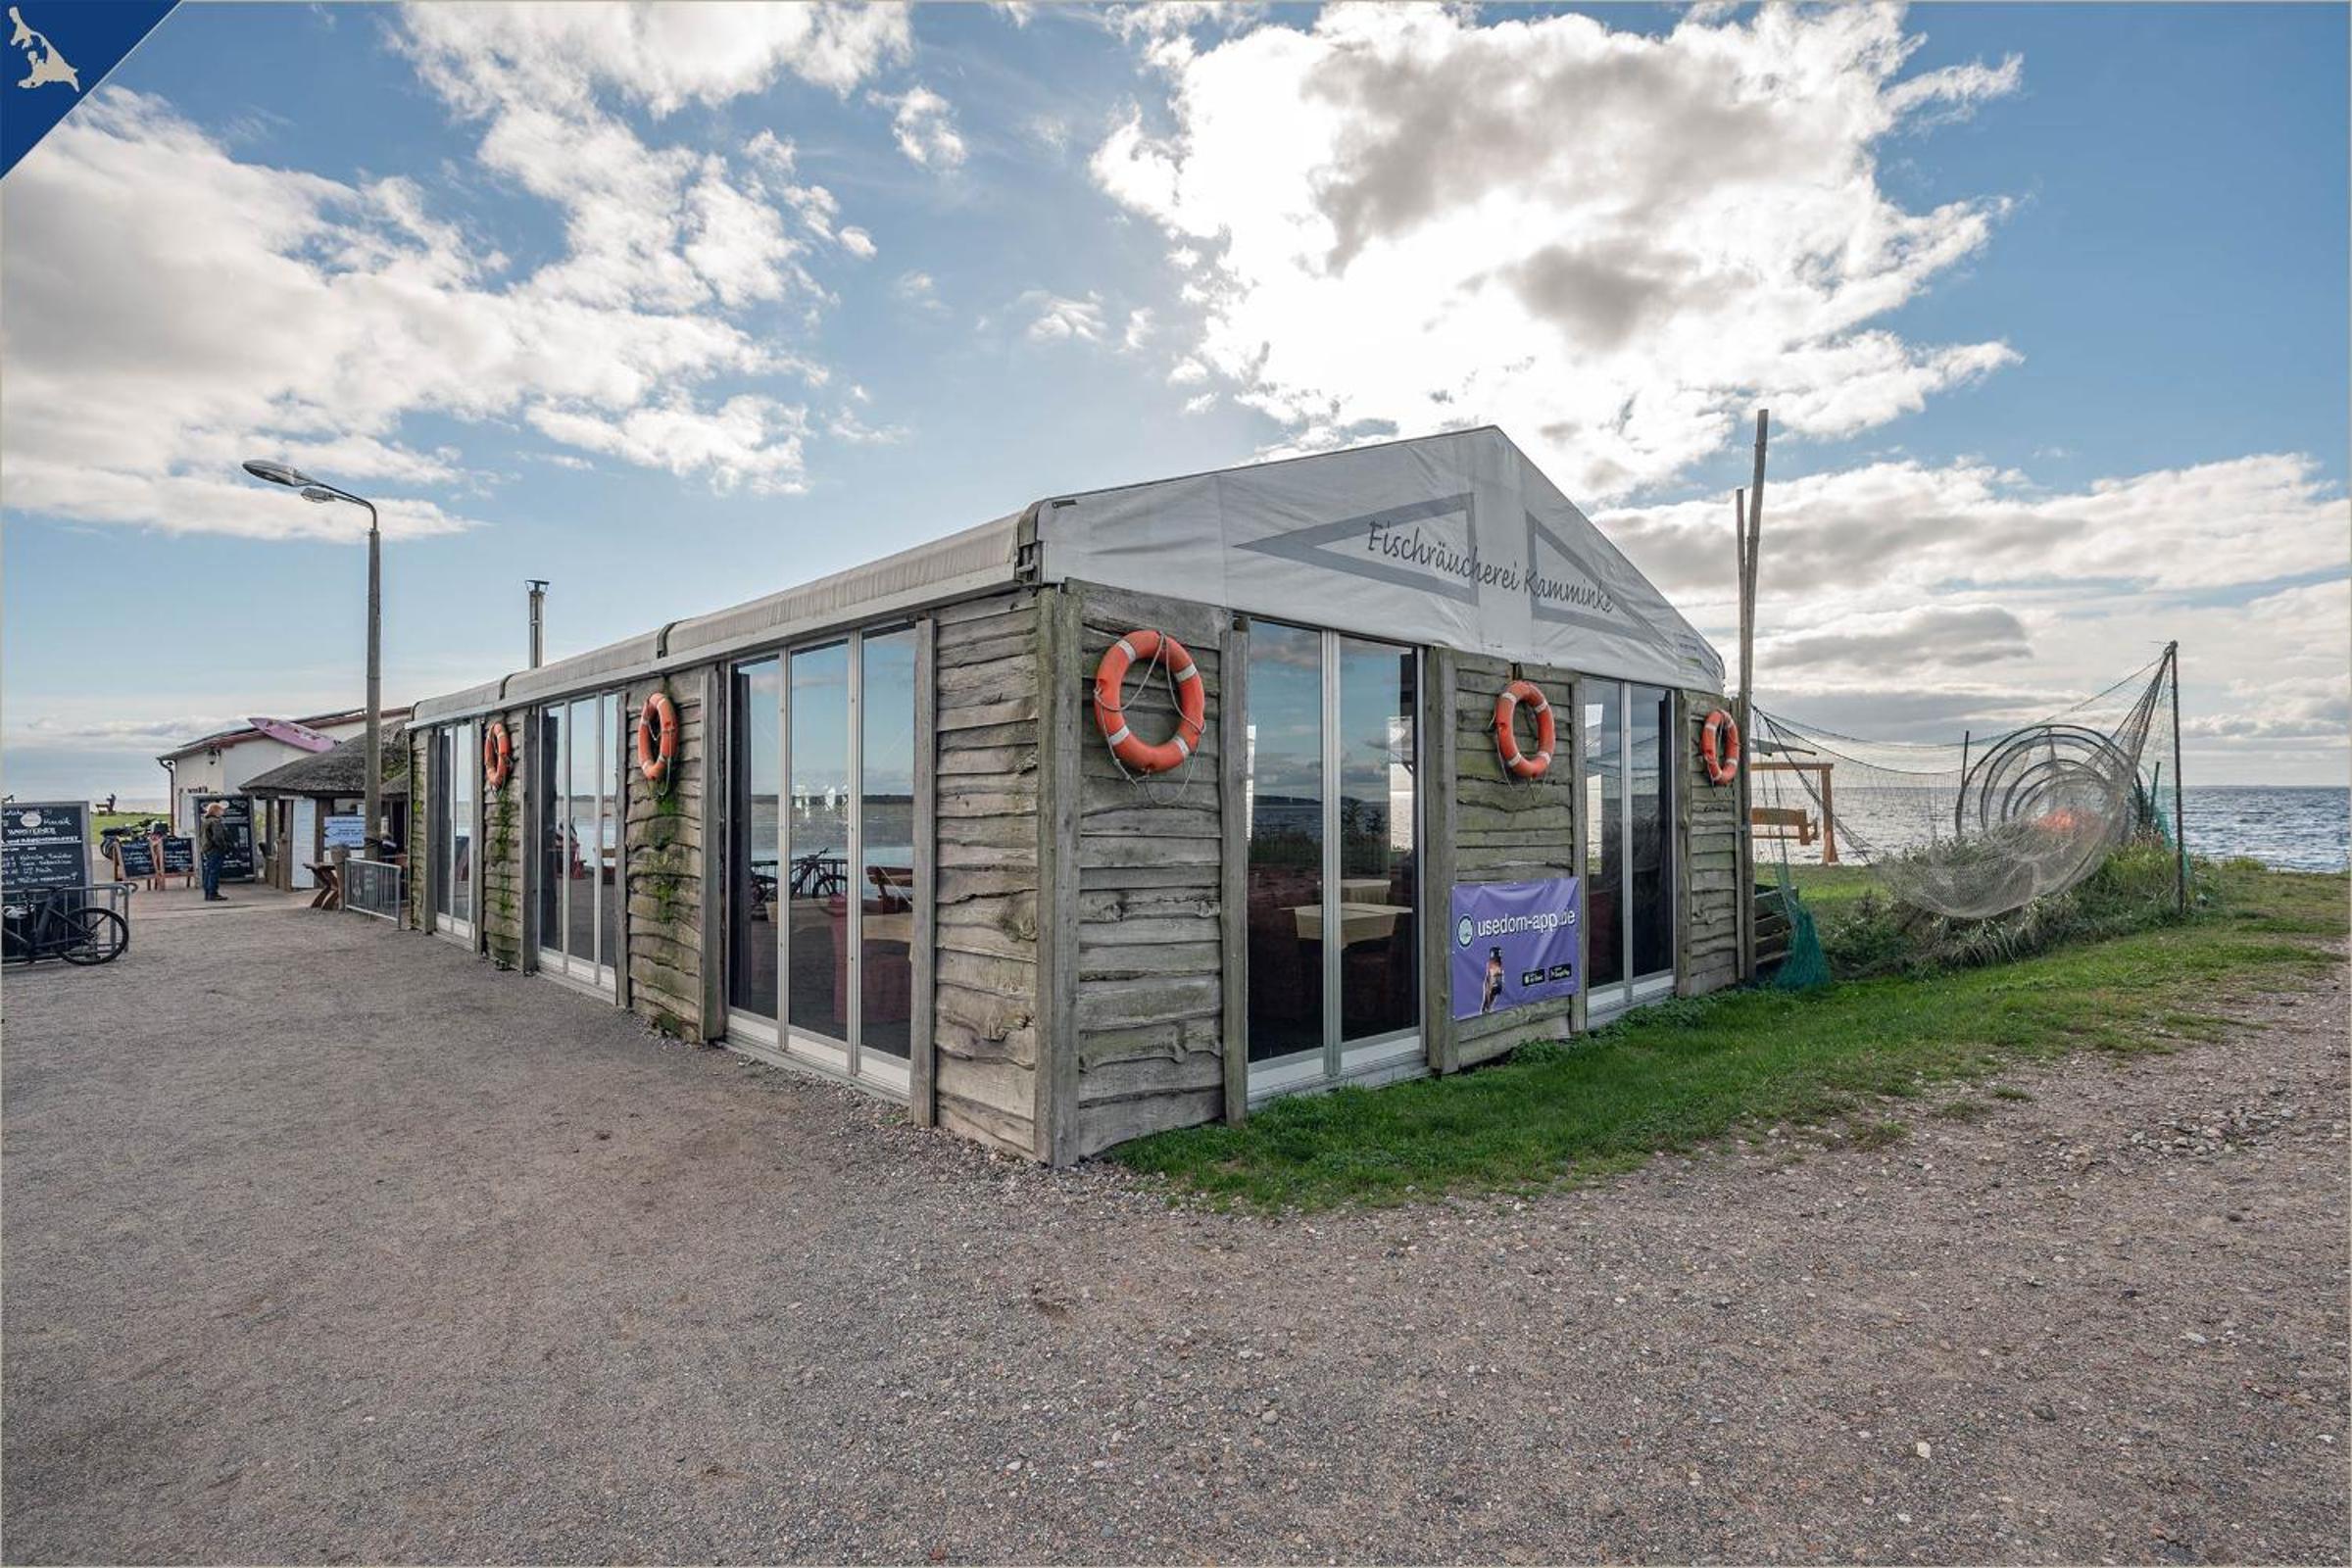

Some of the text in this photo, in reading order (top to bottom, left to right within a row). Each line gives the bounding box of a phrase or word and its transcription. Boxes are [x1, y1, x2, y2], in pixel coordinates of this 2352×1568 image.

[1368, 520, 1615, 613] Fischräucherei Kamminke
[1478, 909, 1576, 936] usedom-app.de
